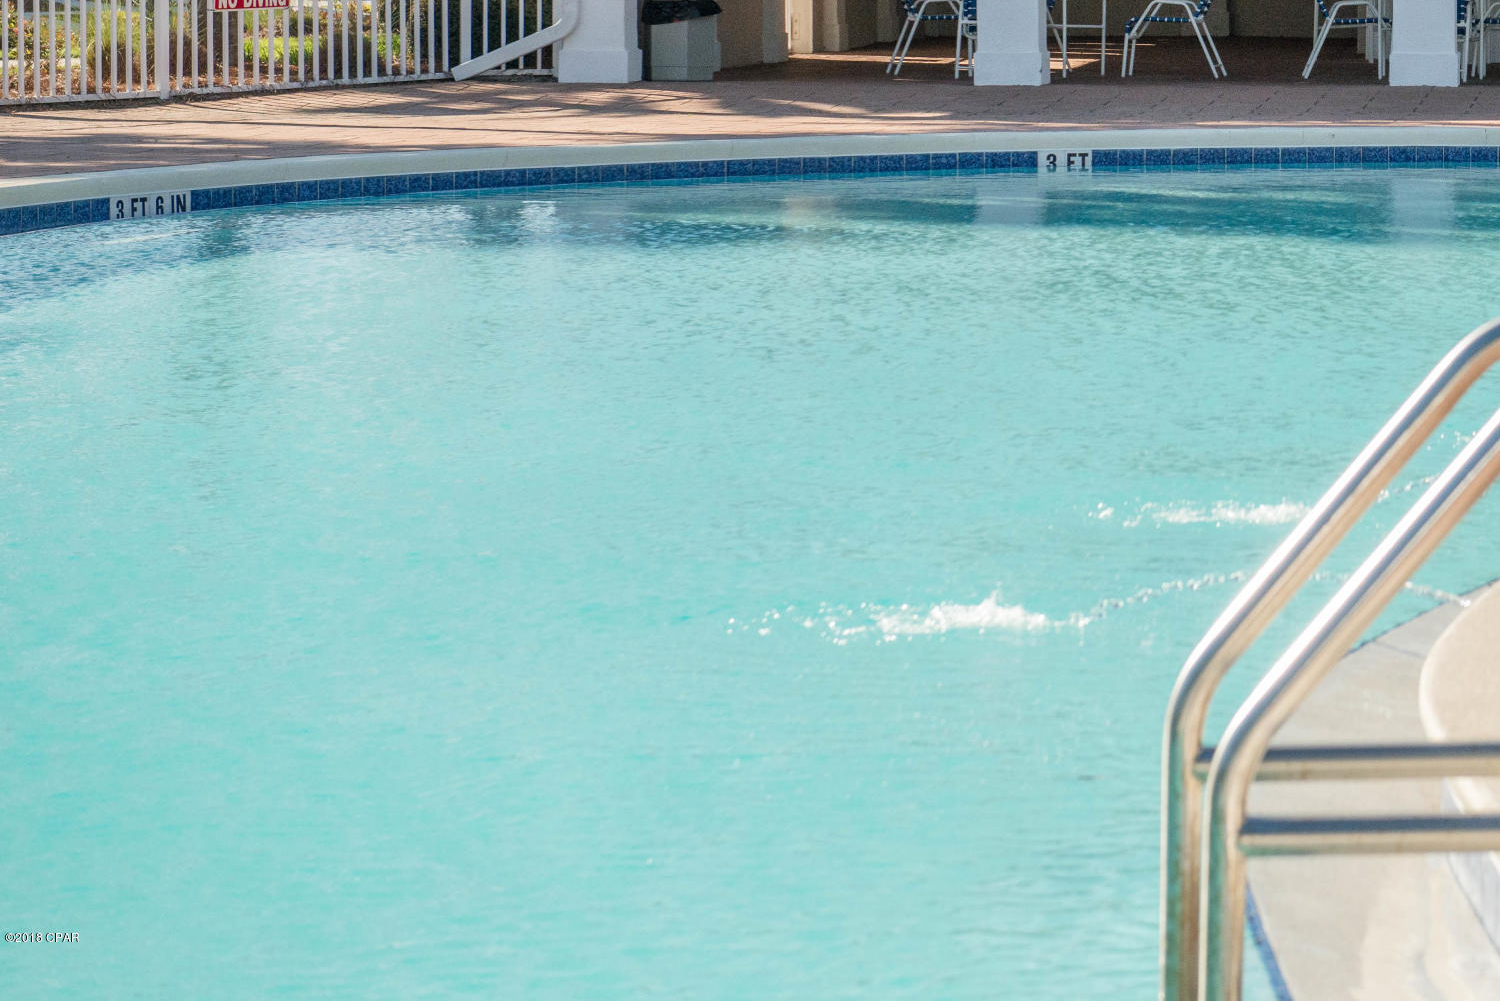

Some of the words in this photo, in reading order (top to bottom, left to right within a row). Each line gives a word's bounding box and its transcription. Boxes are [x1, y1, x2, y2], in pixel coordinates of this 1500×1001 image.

[1046, 153, 1057, 168] 3
[1066, 152, 1089, 168] FT
[116, 200, 125, 219] 3
[130, 197, 148, 217] FT
[170, 193, 187, 214] IN
